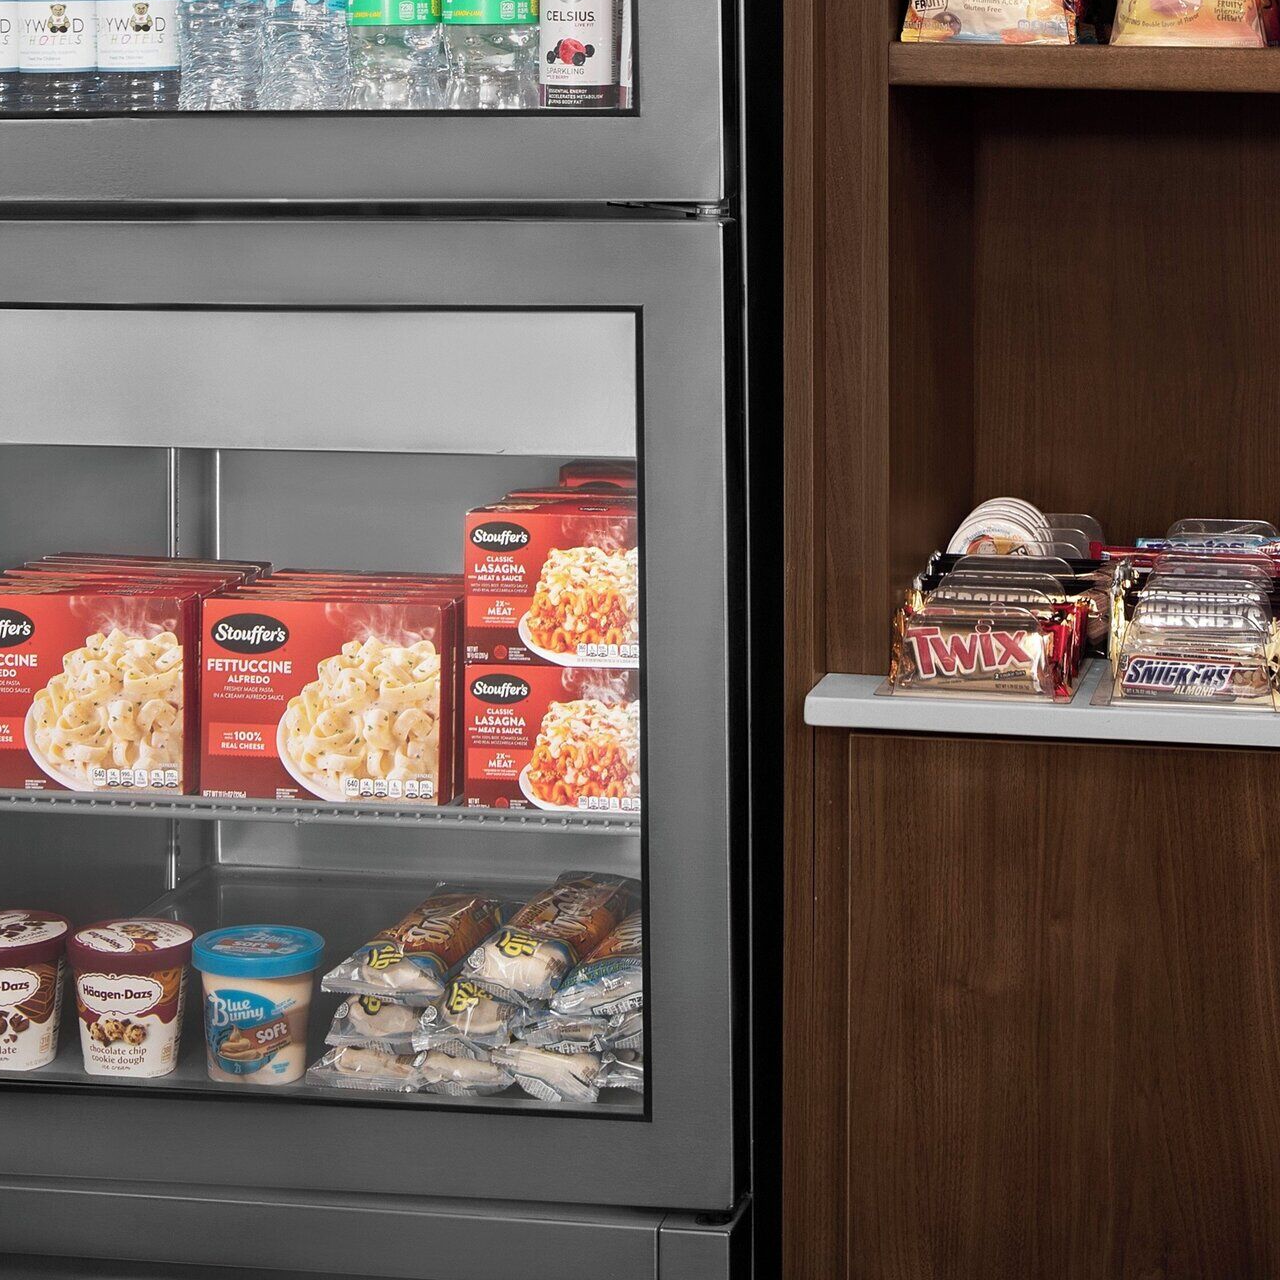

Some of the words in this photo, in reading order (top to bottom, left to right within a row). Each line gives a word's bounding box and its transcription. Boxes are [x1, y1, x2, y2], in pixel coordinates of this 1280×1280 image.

[546, 11, 595, 22] CELSIUS
[473, 530, 528, 545] Stouffer's
[475, 564, 526, 574] LASAGNA
[488, 607, 512, 615] MEAT
[215, 623, 287, 645] Stouffer's
[906, 624, 1032, 679] TWIX
[207, 658, 292, 674] FETTUCCINE
[1126, 660, 1231, 686] SNICKERS
[228, 675, 270, 684] ALFREDO
[473, 682, 528, 697] Stouffer's
[1173, 685, 1216, 697] ALMOND
[475, 716, 526, 726] LASAGNA
[234, 732, 262, 742] 100%
[488, 759, 512, 768] MEAT
[83, 985, 152, 1000] Häagen-Dazs
[90, 1045, 127, 1055] chocolate
[128, 1047, 147, 1056] chip
[92, 1056, 115, 1064] cookie
[118, 1055, 144, 1065] dough
